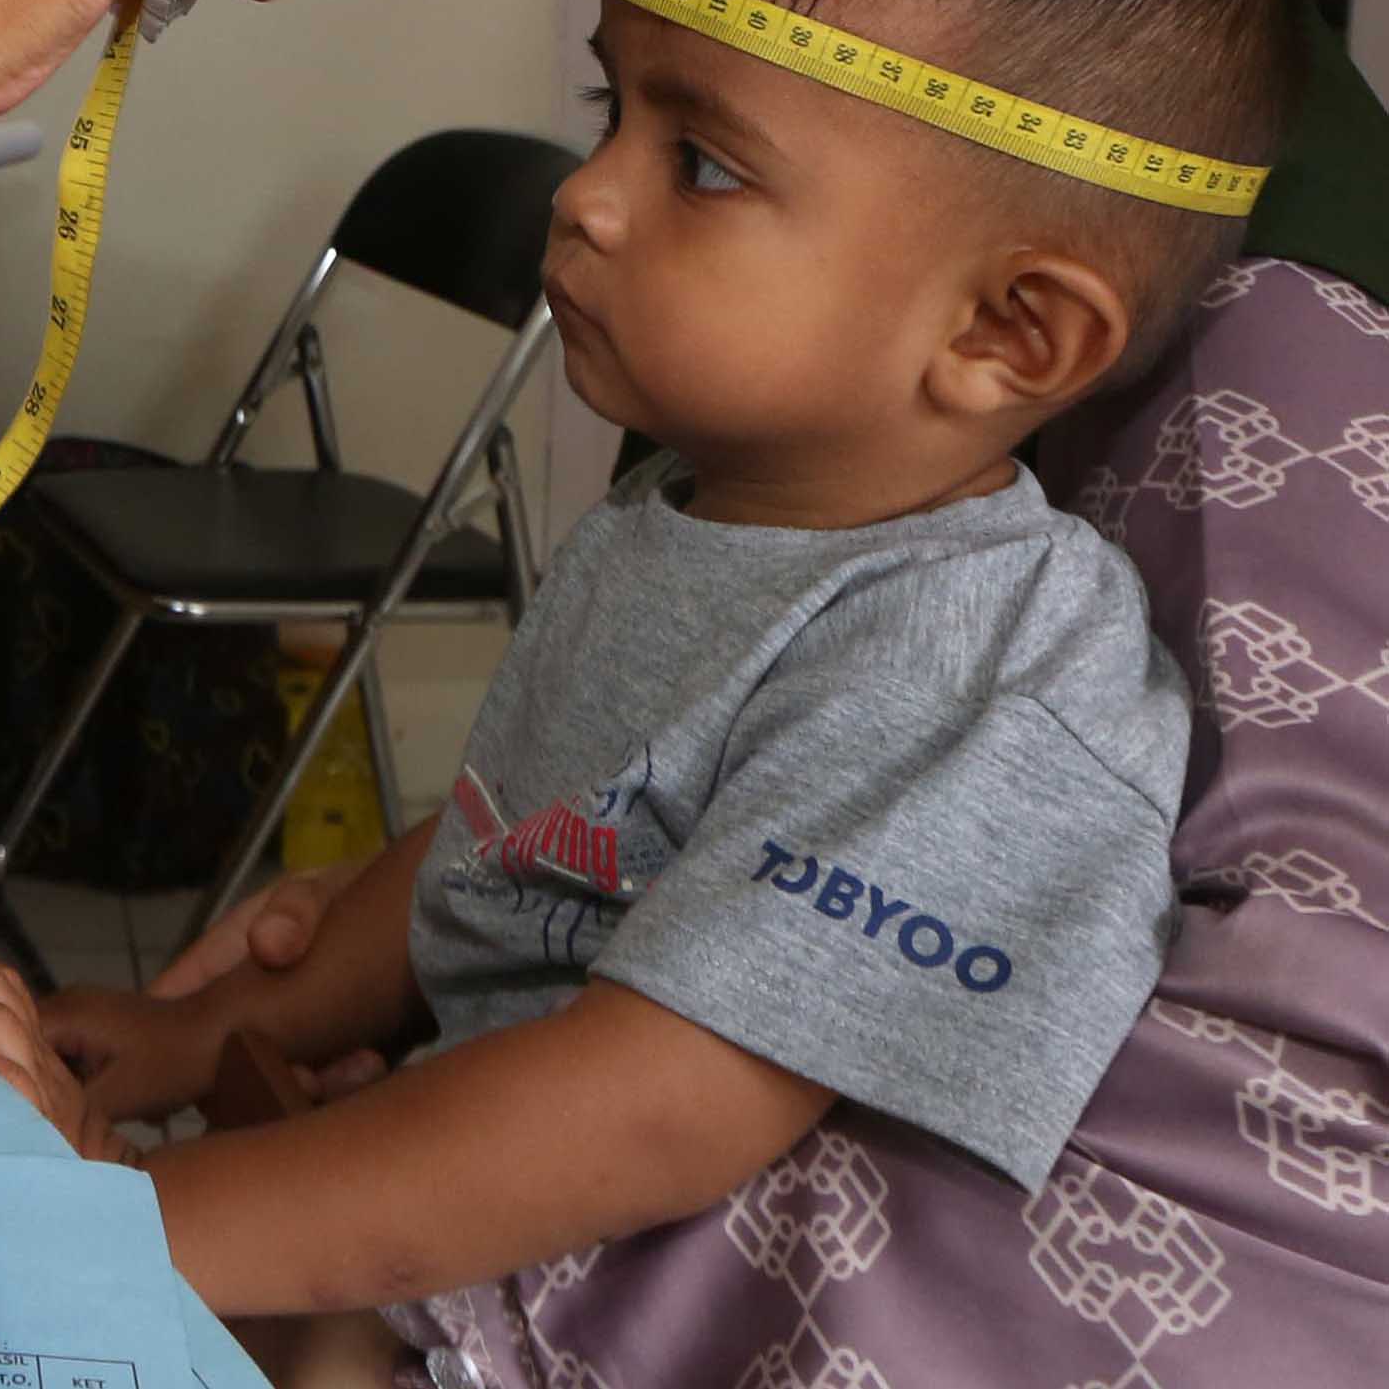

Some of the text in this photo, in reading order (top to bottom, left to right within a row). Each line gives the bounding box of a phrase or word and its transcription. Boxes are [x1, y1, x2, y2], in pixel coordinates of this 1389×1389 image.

[746, 9, 770, 31] 40
[790, 24, 814, 50] 39
[835, 42, 860, 67] 38
[880, 60, 904, 84] 37
[923, 77, 950, 101] 36
[971, 94, 997, 118] 35
[70, 118, 95, 152] 25
[1017, 111, 1043, 135] 34
[1063, 128, 1088, 152] 33
[1107, 142, 1130, 168] 32
[1144, 155, 1165, 175] 31
[58, 206, 79, 243] 26
[50, 294, 70, 332] 27
[22, 380, 48, 418] 28
[751, 840, 1013, 993] TOBYOO
[72, 1378, 106, 1389] KET
